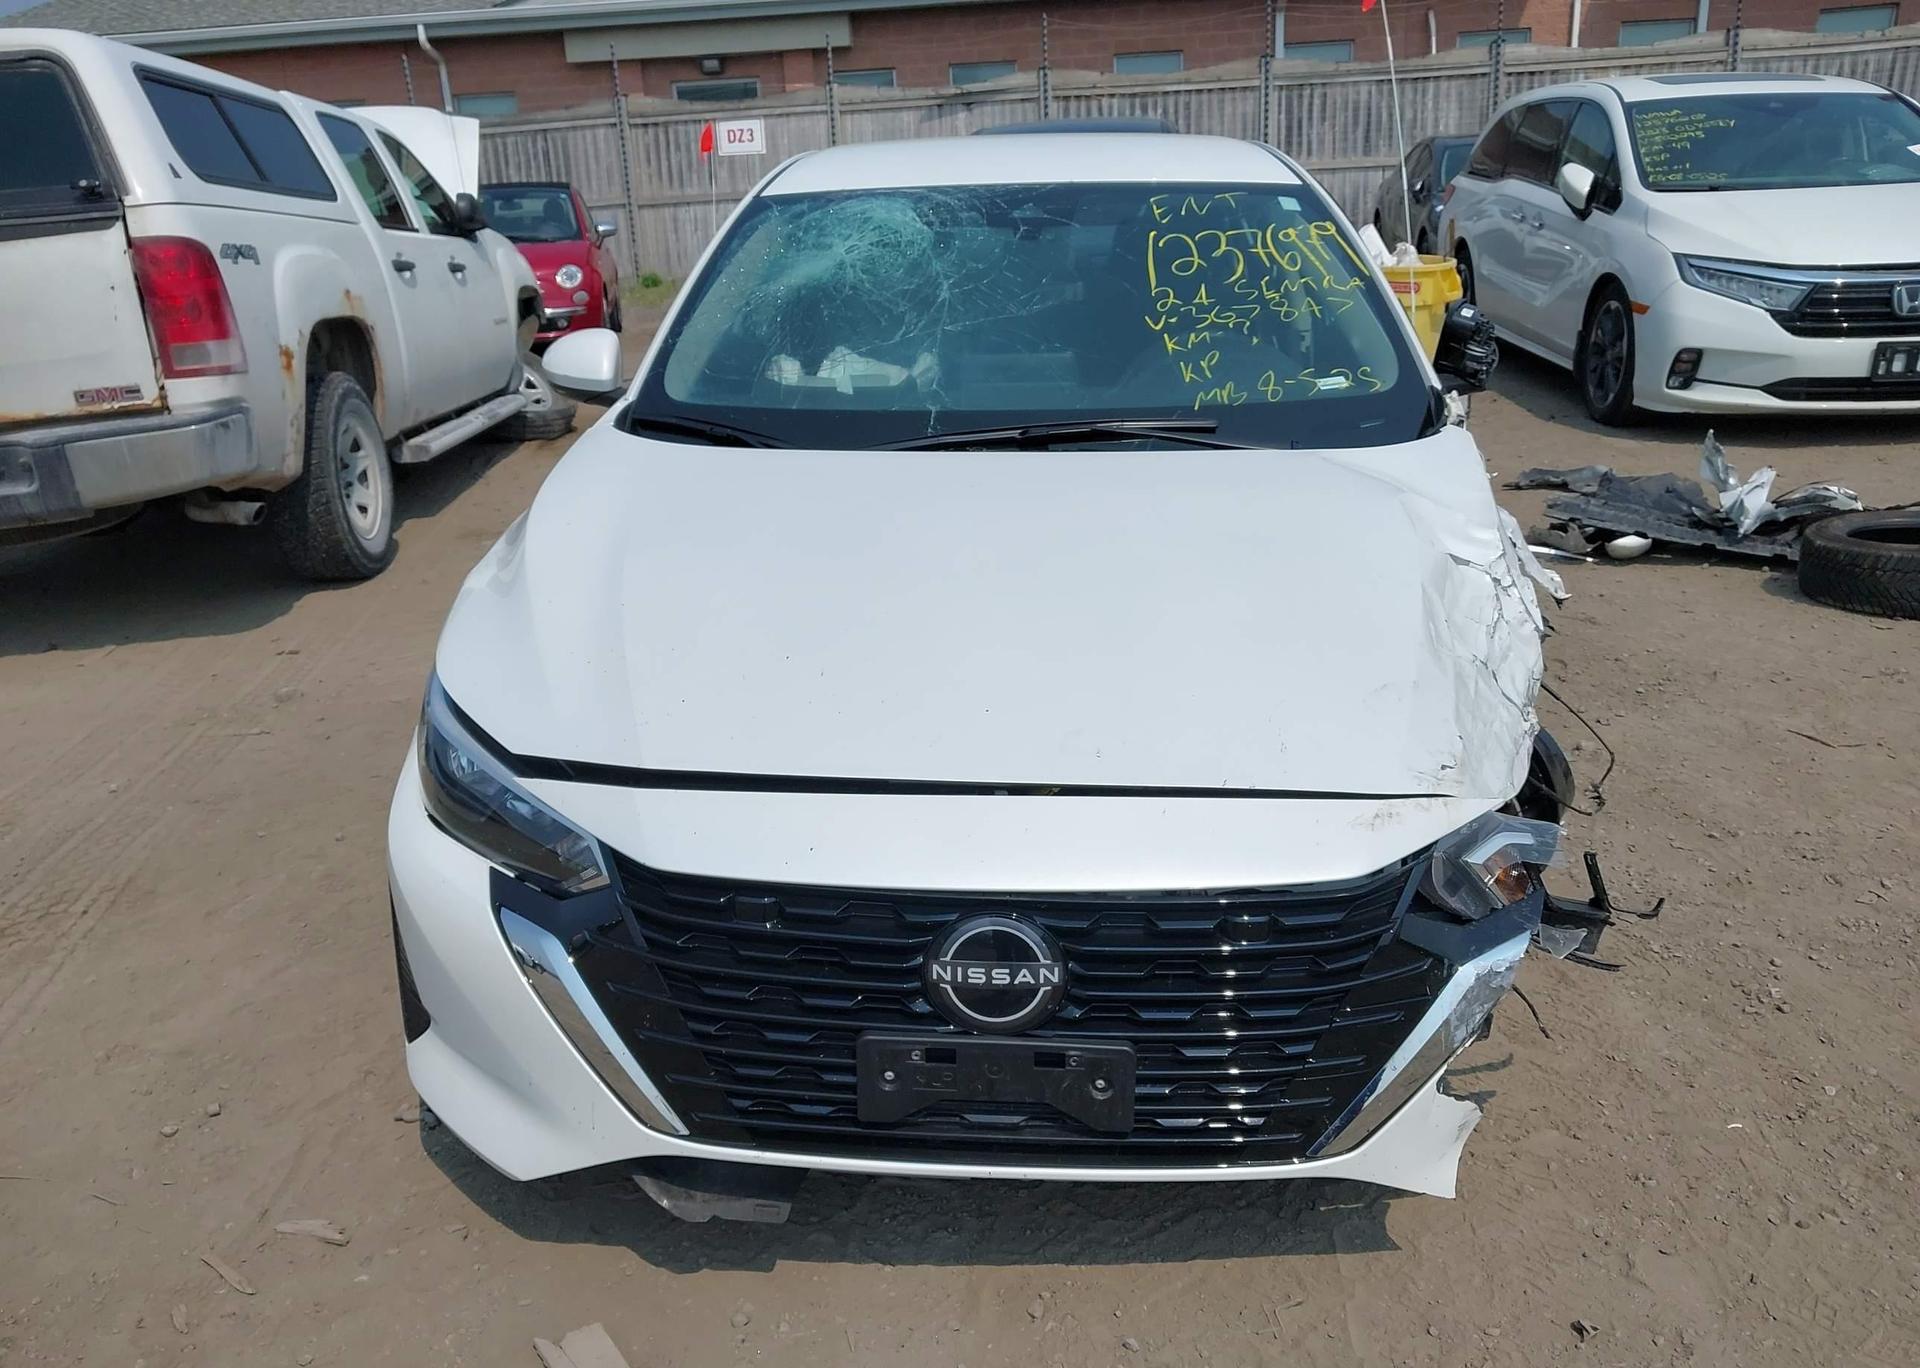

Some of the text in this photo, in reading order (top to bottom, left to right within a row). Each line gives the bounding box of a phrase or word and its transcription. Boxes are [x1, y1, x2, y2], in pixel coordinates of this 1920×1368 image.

[727, 128, 754, 144] DZ3
[1150, 192, 1248, 223] ENT
[1234, 275, 1365, 300] SENTRA
[1180, 350, 1220, 384] KP
[73, 385, 144, 406] GMC
[931, 963, 1061, 985] NISSAN
